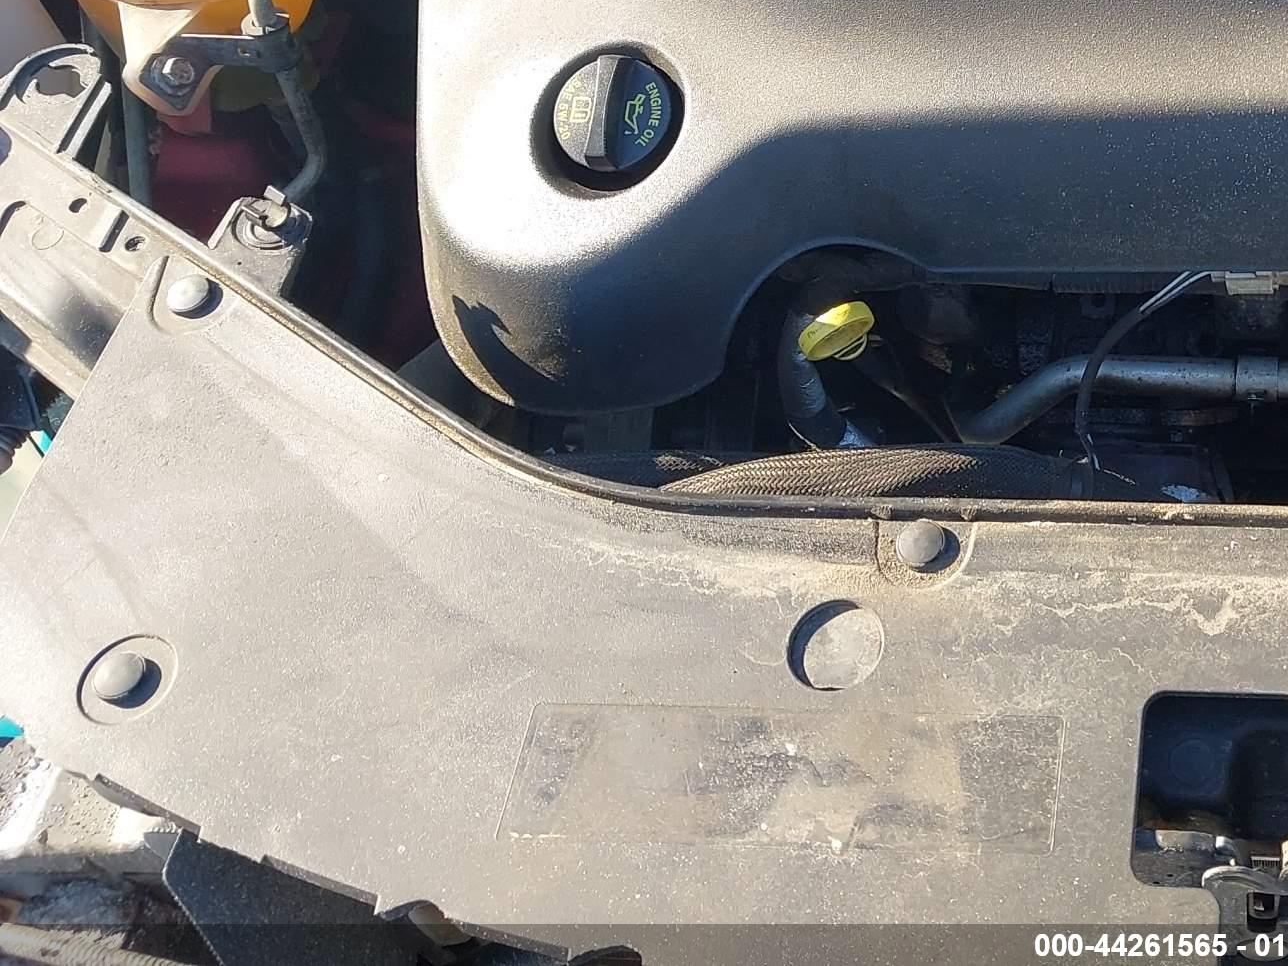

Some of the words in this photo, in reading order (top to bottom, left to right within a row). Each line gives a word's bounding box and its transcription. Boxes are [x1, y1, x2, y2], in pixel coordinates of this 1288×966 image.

[562, 79, 581, 101] SAE
[645, 81, 662, 128] ENGINE
[557, 103, 571, 140] 5W-20
[634, 129, 655, 147] OIL
